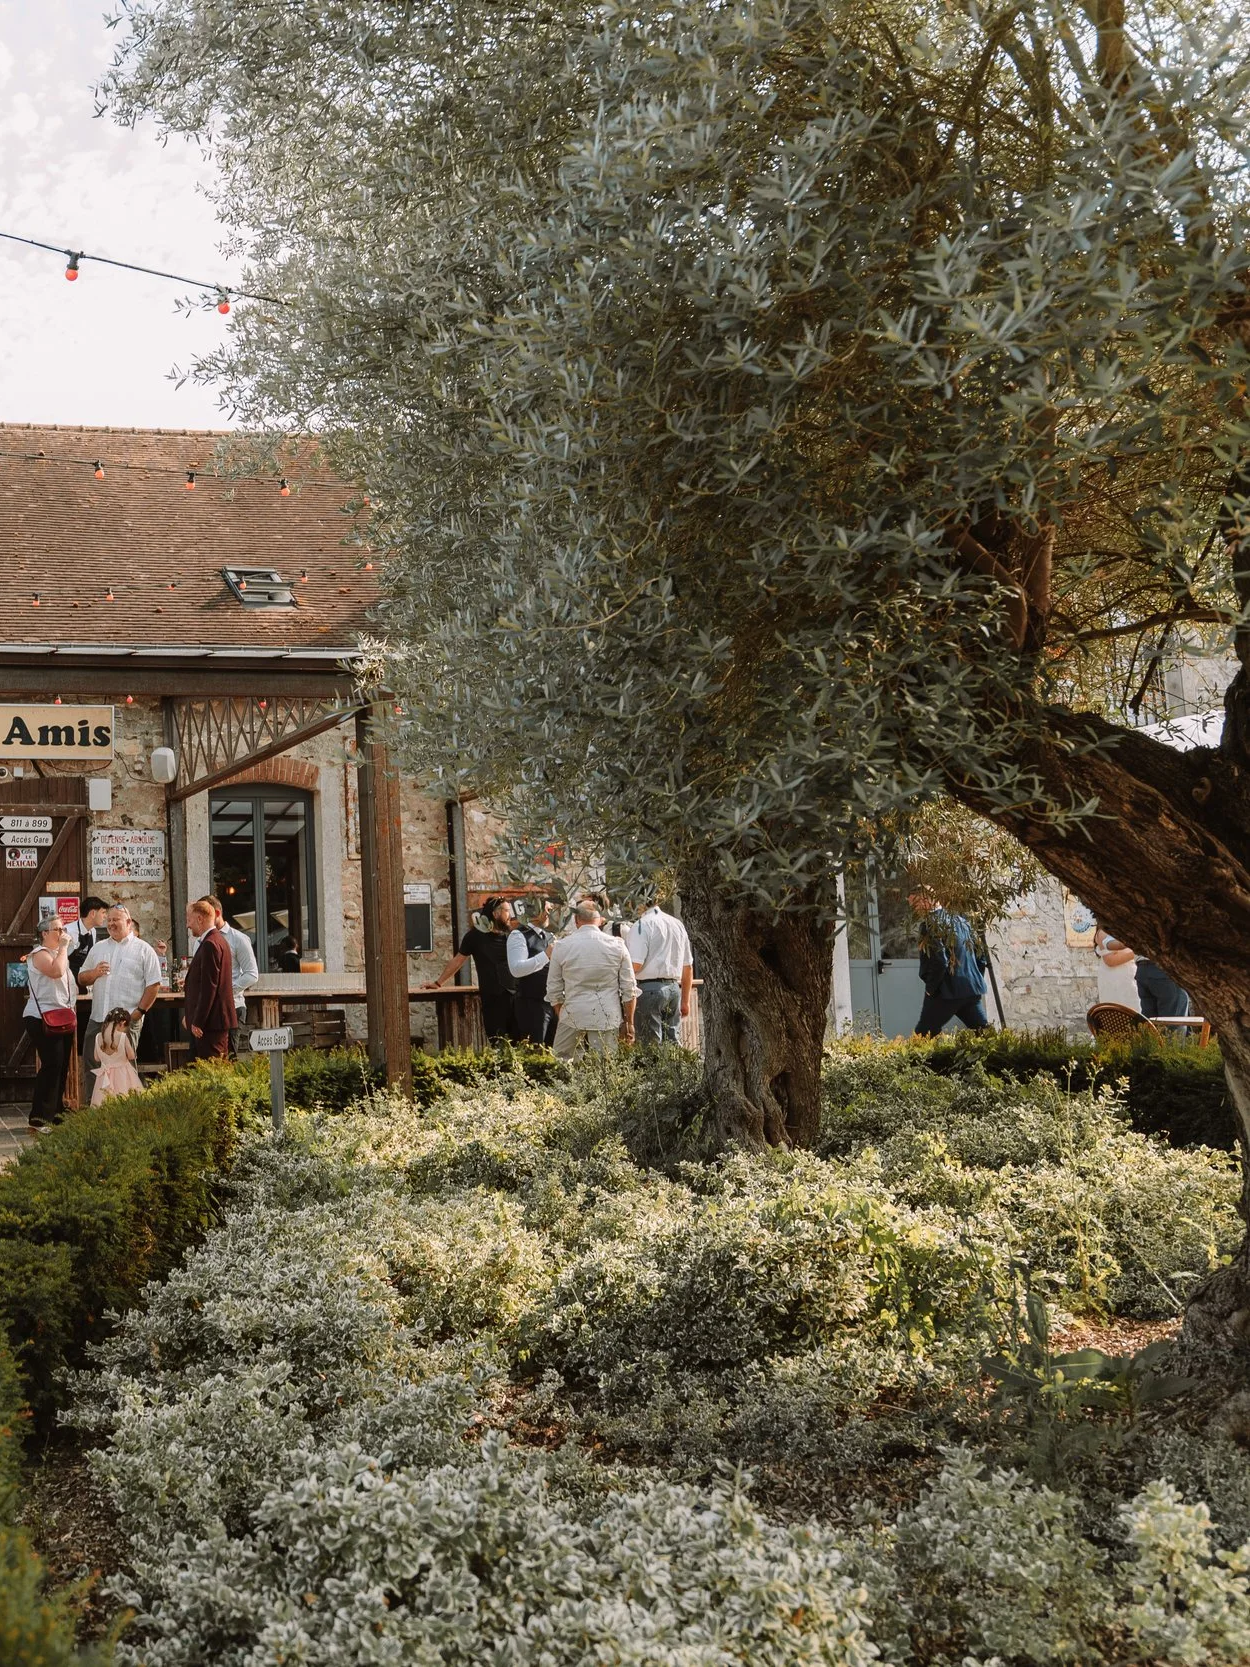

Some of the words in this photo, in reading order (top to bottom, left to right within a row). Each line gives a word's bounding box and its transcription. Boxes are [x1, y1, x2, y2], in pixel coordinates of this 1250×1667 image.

[2, 716, 111, 748] Amis
[10, 819, 23, 828] 811
[31, 819, 48, 828] 899
[11, 835, 31, 844] Accès
[33, 835, 50, 844] Gare
[94, 847, 101, 855] DE
[94, 858, 107, 866] DANS
[132, 858, 144, 866] AVEC
[97, 869, 104, 877] OU
[274, 1033, 286, 1045] Gare
